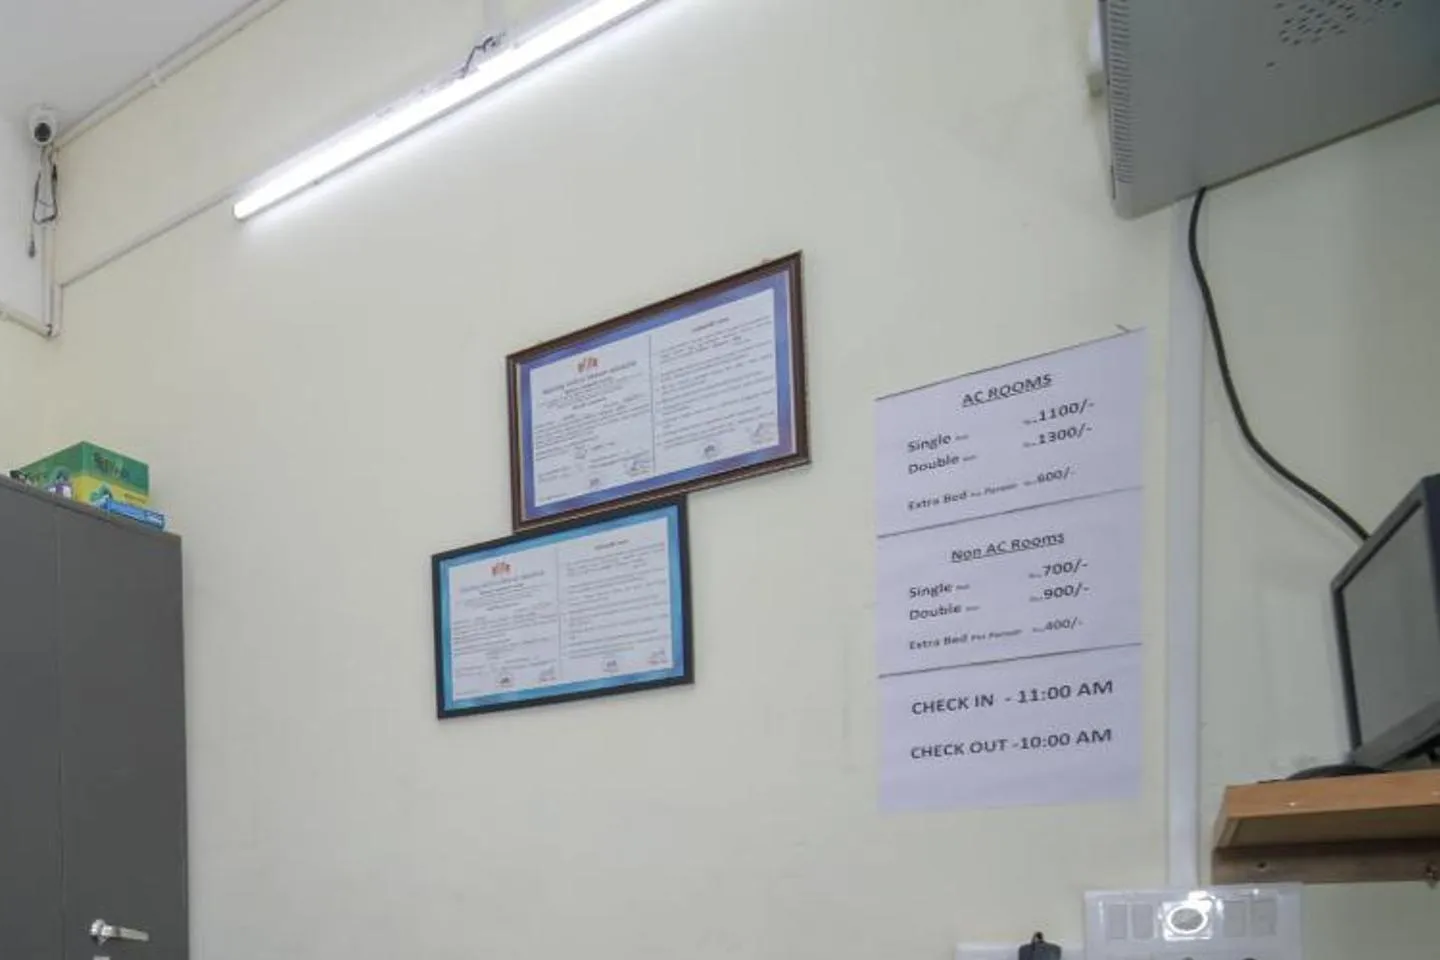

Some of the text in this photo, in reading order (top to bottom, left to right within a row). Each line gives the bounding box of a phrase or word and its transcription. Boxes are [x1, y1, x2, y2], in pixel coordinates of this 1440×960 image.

[962, 374, 1053, 406] AC ROOMS
[907, 434, 951, 452] Single
[908, 454, 959, 475] Double
[908, 498, 939, 511] Extra
[944, 490, 967, 504] Bed
[950, 532, 1065, 563] Non AC Rooms
[909, 582, 952, 598] Single
[909, 602, 961, 620] Double
[910, 638, 940, 649] Extra
[944, 634, 967, 645] Bed
[911, 697, 968, 715] CHECK
[974, 694, 994, 707] IN
[1018, 684, 1071, 704] 11:00
[1076, 680, 1113, 697] AM
[911, 743, 964, 760] CHECK
[969, 739, 1008, 755] OUT
[1076, 728, 1112, 744] AM
